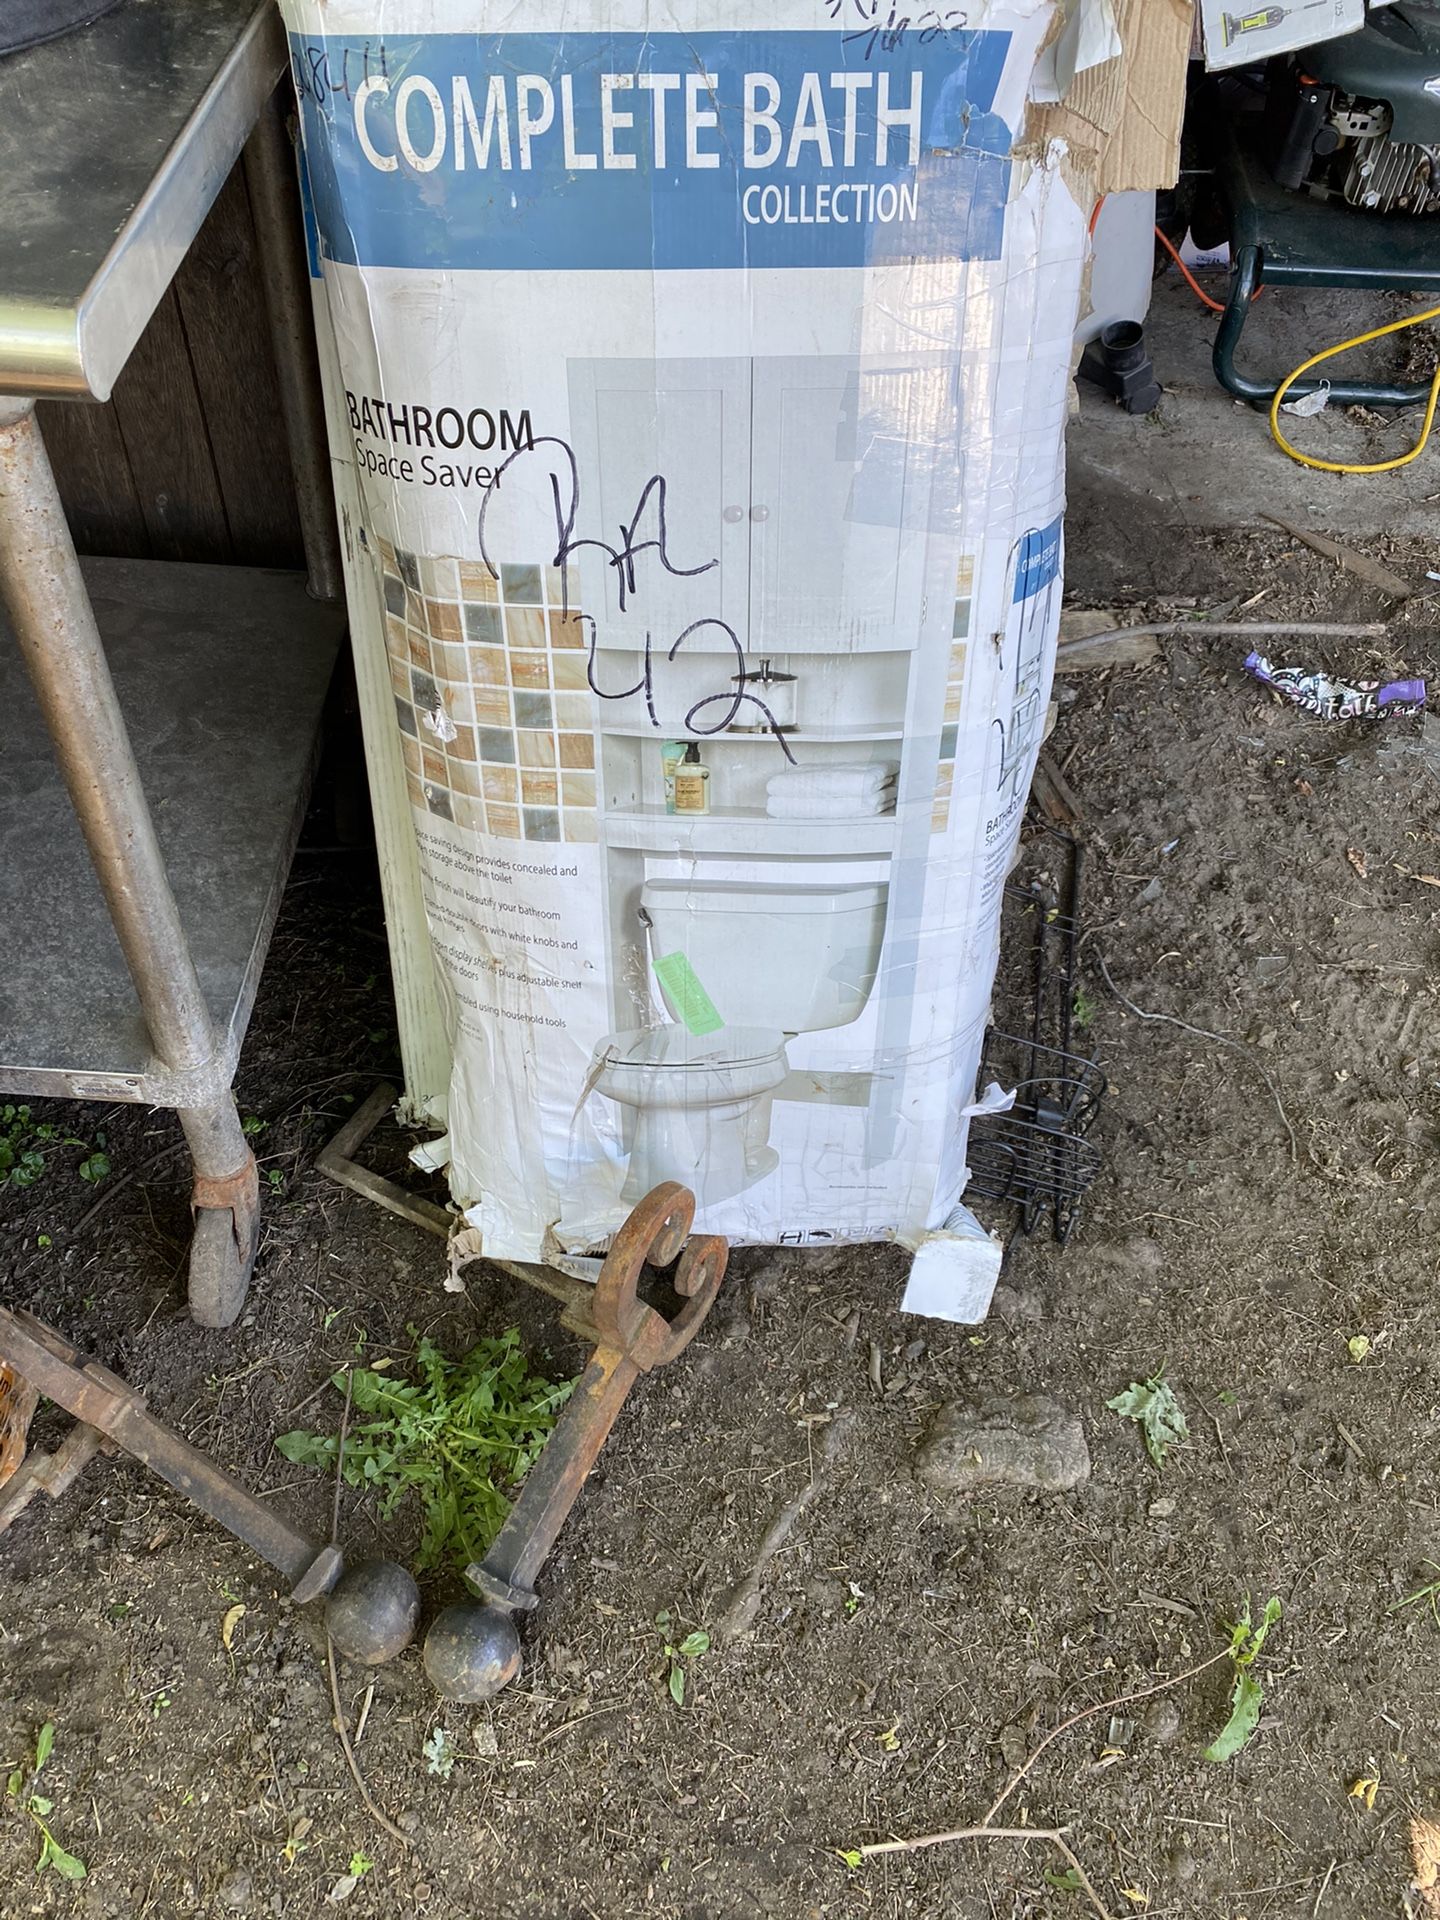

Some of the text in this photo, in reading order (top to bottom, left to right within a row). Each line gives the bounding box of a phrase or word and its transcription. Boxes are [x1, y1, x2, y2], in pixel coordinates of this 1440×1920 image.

[354, 70, 923, 172] COMPLETE BATH
[743, 183, 917, 225] COLLECTION
[345, 391, 534, 451] BATHROOM
[355, 437, 500, 489] Space Saver
[428, 848, 453, 867] storage
[454, 859, 475, 875] above
[476, 868, 489, 879] the
[491, 872, 512, 885] toilet
[429, 835, 452, 852] saving
[452, 843, 475, 861] design
[475, 855, 510, 870] provides
[512, 862, 558, 876] concealed
[560, 865, 578, 877] and
[466, 890, 496, 910] beautify
[498, 902, 516, 912] your
[518, 904, 560, 920] bathroom
[490, 927, 507, 938] with
[508, 931, 531, 944] white
[533, 934, 559, 948] knobs
[561, 940, 578, 950] and
[449, 946, 473, 965] display
[499, 965, 515, 979] plus
[517, 973, 560, 988] adjustable
[459, 966, 479, 981] doors
[479, 1004, 500, 1018] using
[501, 1009, 543, 1025] household
[545, 1017, 567, 1029] tools
